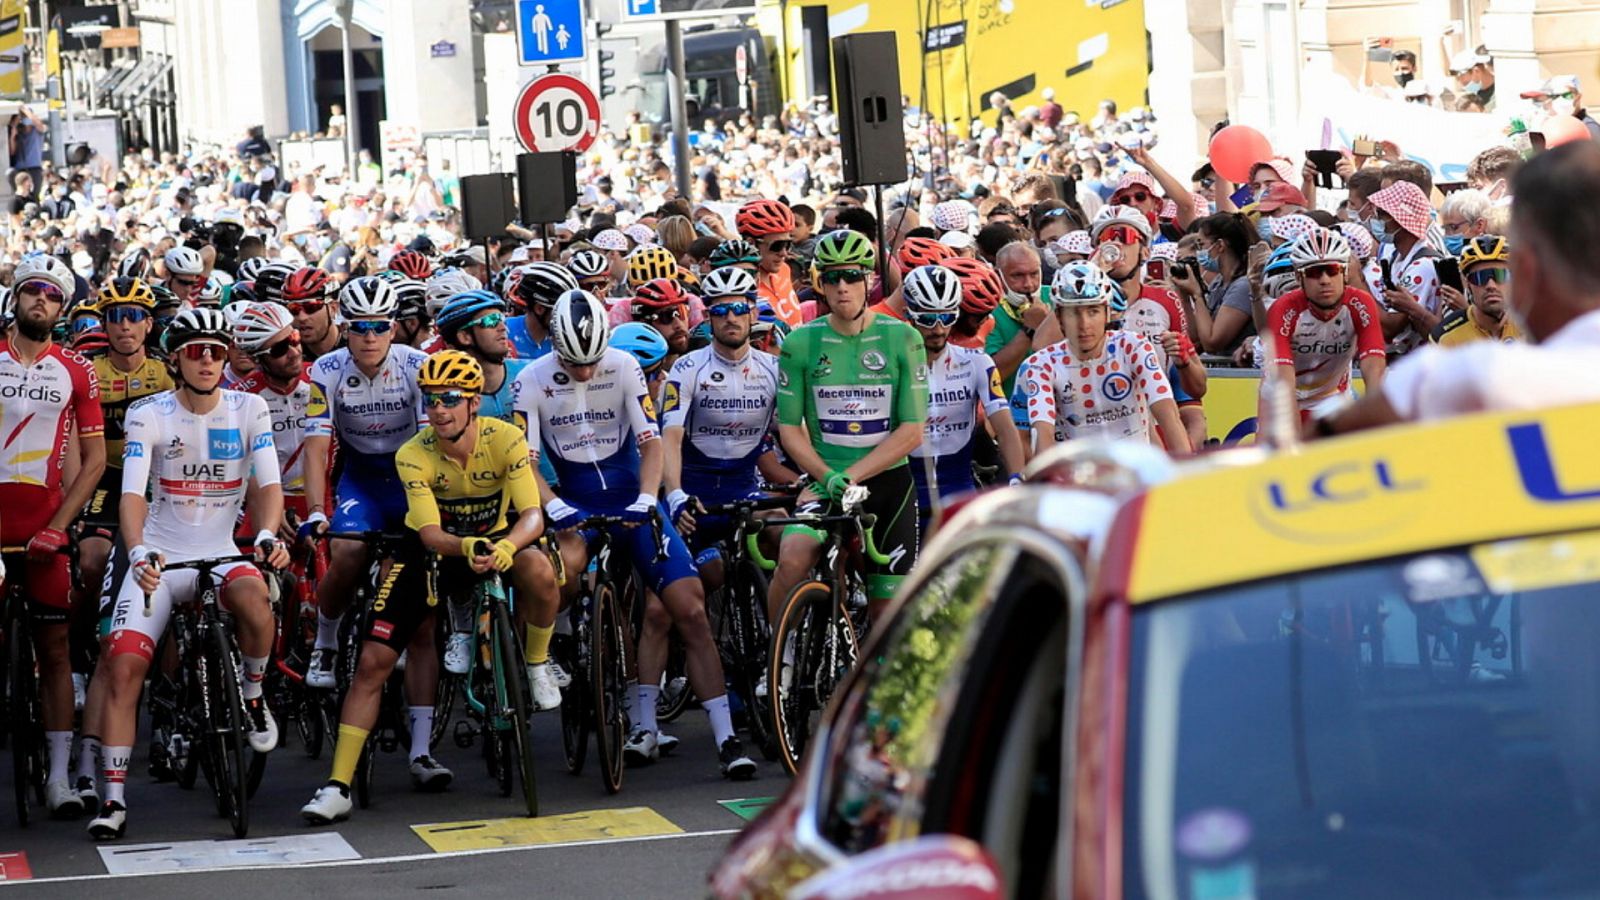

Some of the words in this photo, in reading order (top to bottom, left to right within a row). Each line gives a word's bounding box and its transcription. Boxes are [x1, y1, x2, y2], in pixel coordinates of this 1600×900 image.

[536, 98, 583, 138] 10
[61, 347, 100, 400] Cofidis
[0, 384, 62, 403] ofidis
[817, 388, 886, 399] deceuninck
[928, 386, 972, 403] uninck
[340, 397, 412, 414] deceuninck
[700, 395, 768, 410] deceuninck
[550, 408, 616, 426] deceuninck
[1085, 408, 1137, 424] MONDIALE
[212, 440, 240, 454] Krys
[183, 464, 226, 477] UAE
[472, 471, 499, 481] LCL
[181, 481, 225, 490] Emirates
[1266, 460, 1430, 513] LCL
[373, 563, 406, 612] JUMBO
[113, 599, 131, 627] UAE
